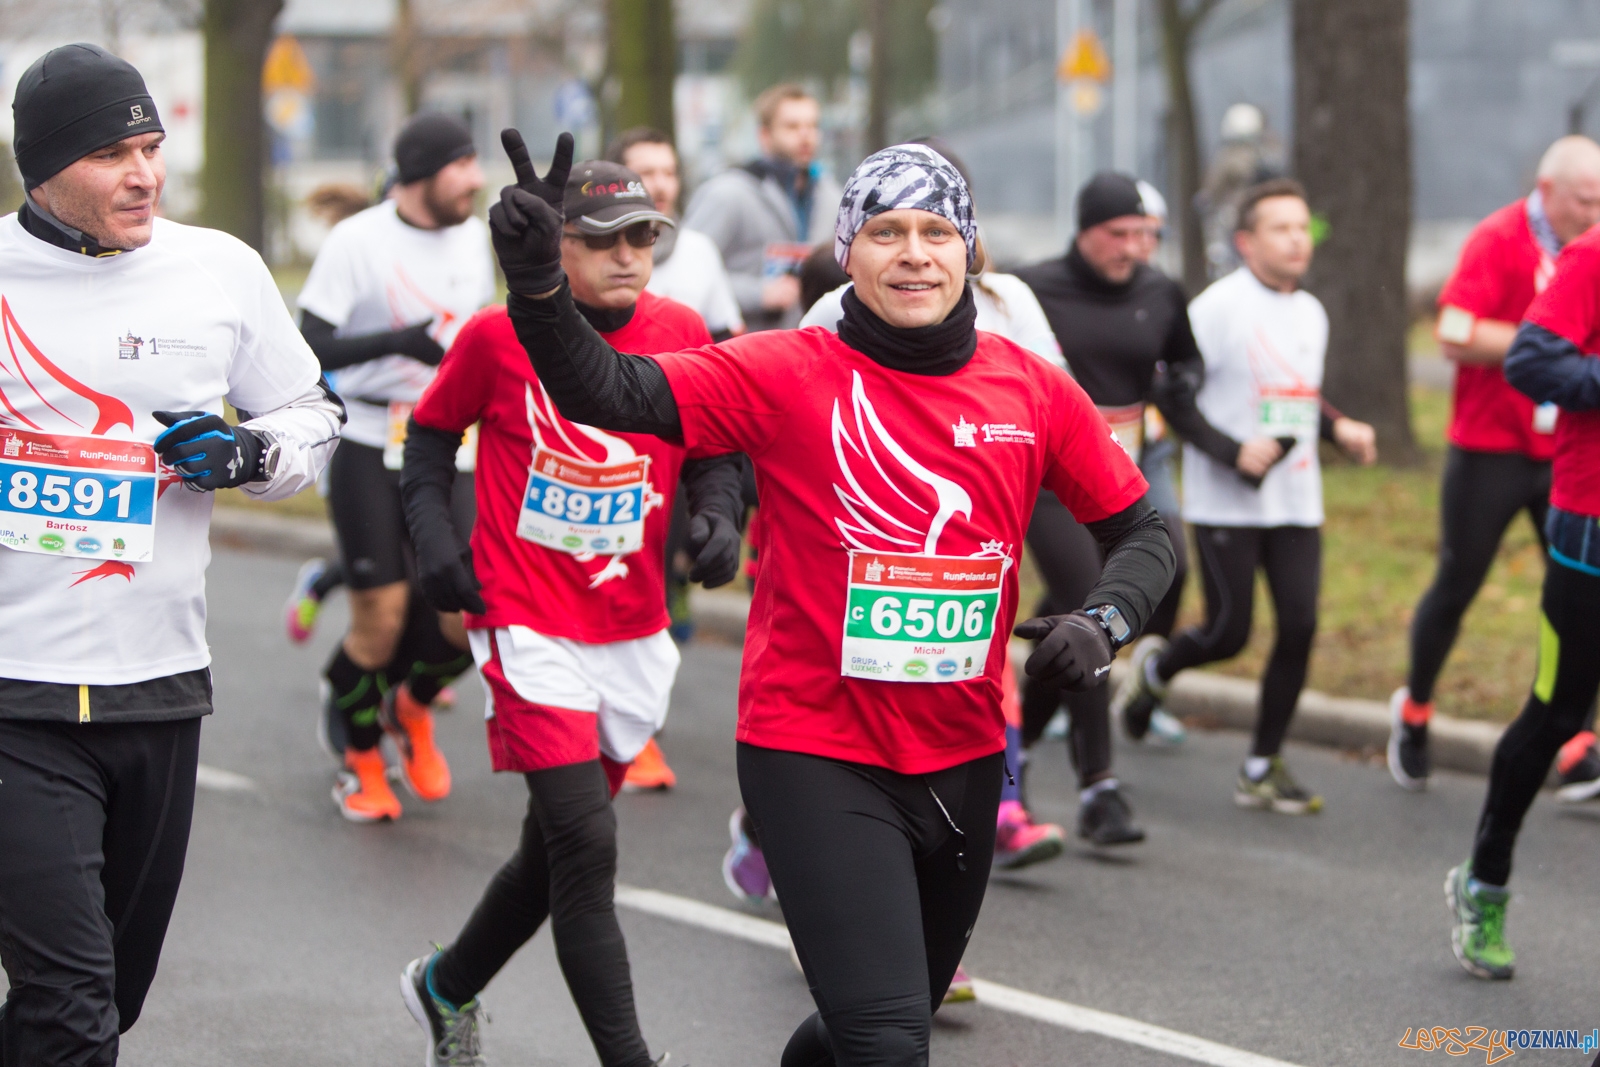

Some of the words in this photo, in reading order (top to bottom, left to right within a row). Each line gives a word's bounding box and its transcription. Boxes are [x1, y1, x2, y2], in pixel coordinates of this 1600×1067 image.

[127, 116, 152, 126] salomon
[149, 338, 159, 355] 1
[981, 423, 994, 443] 1
[26, 441, 33, 454] 1
[80, 450, 146, 464] RunPoland.org
[8, 471, 132, 518] 8591
[530, 487, 540, 501] E
[542, 484, 635, 523] 8912
[46, 520, 88, 532] Bartosz
[888, 565, 895, 579] 1
[943, 572, 997, 582] RunPoland.org
[870, 596, 986, 638] 6506
[914, 646, 946, 655] Michał
[851, 656, 878, 666] GRUPA
[851, 664, 882, 674] LUXMED
